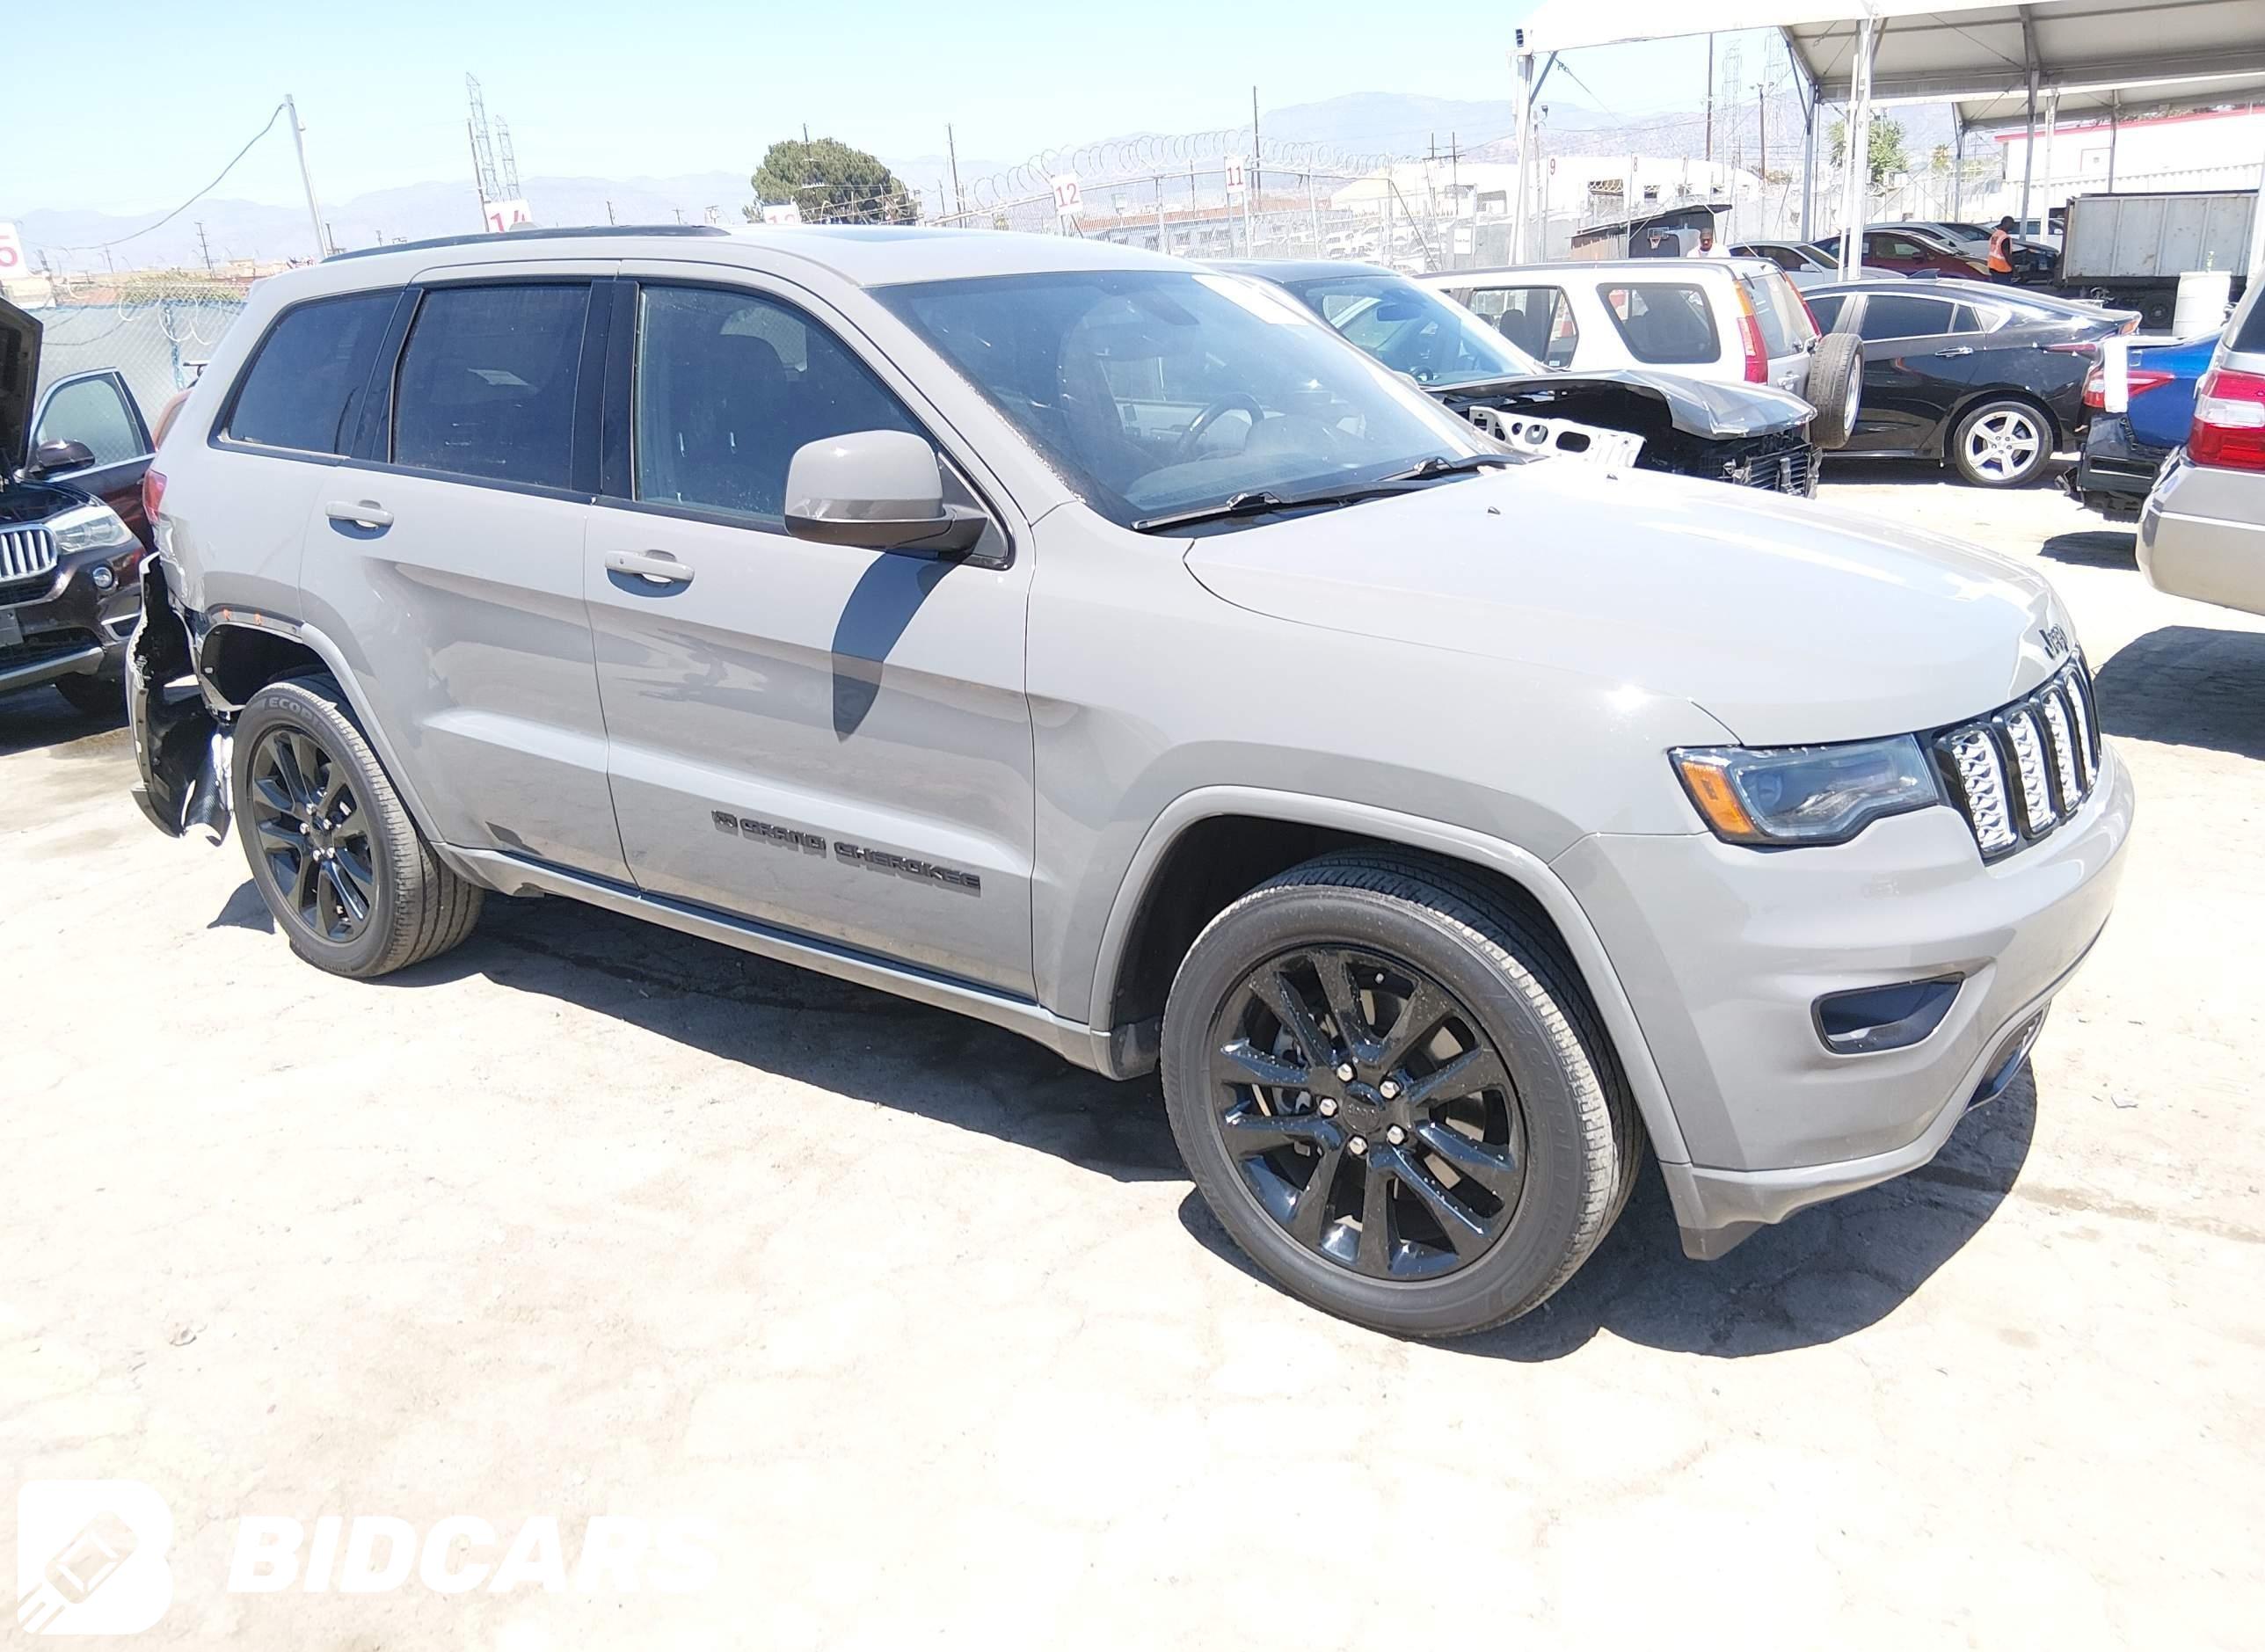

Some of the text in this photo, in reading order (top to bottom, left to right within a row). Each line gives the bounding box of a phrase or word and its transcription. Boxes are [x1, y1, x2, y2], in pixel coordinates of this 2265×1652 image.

[1227, 165, 1244, 186] 11
[1549, 157, 1556, 176] 9
[1056, 183, 1080, 207] 12
[2038, 622, 2070, 660] Jeep
[739, 818, 981, 891] GRAND CHEROKEE
